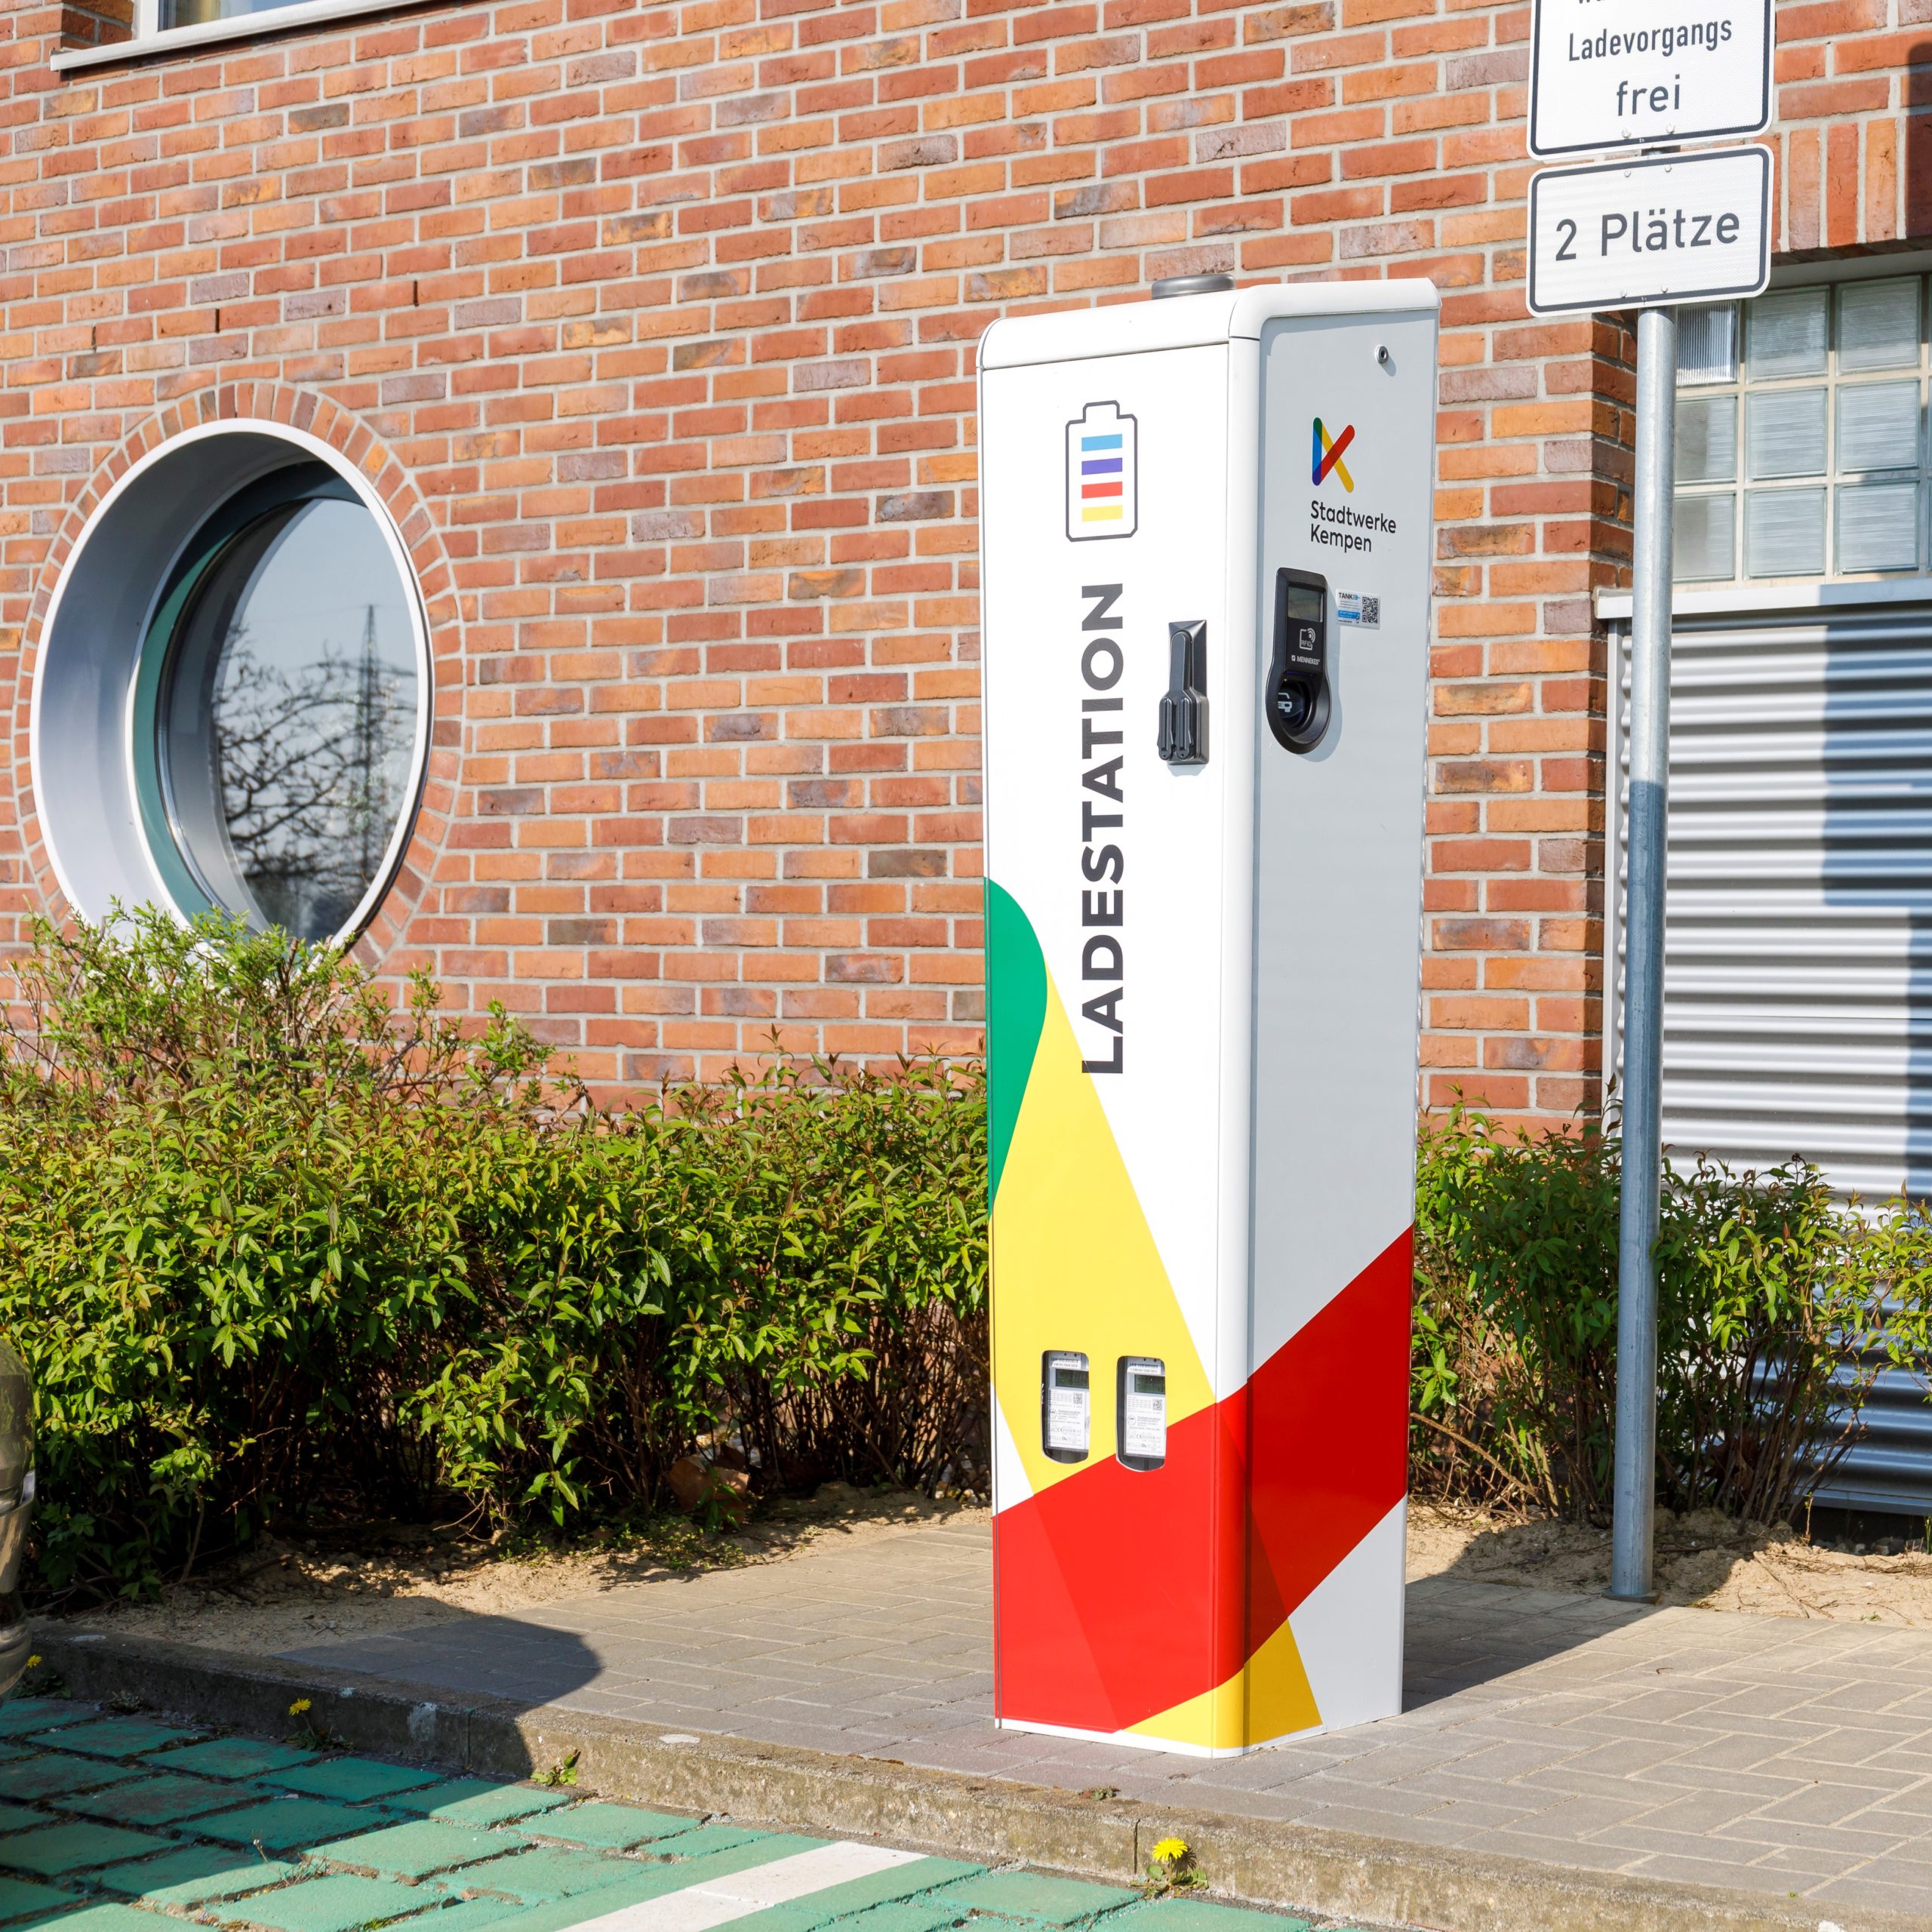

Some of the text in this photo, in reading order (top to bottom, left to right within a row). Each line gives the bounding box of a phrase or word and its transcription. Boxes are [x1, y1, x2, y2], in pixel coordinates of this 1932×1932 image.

[1568, 19, 1733, 62] Ladevorgangs
[1616, 74, 1681, 116] frei
[1555, 208, 1740, 261] 2 Plätze
[1310, 500, 1397, 534] Stadtwerke
[1310, 523, 1372, 553] Kempen
[1300, 639, 1312, 648] RFID
[1081, 583, 1124, 1075] LADESTATION
